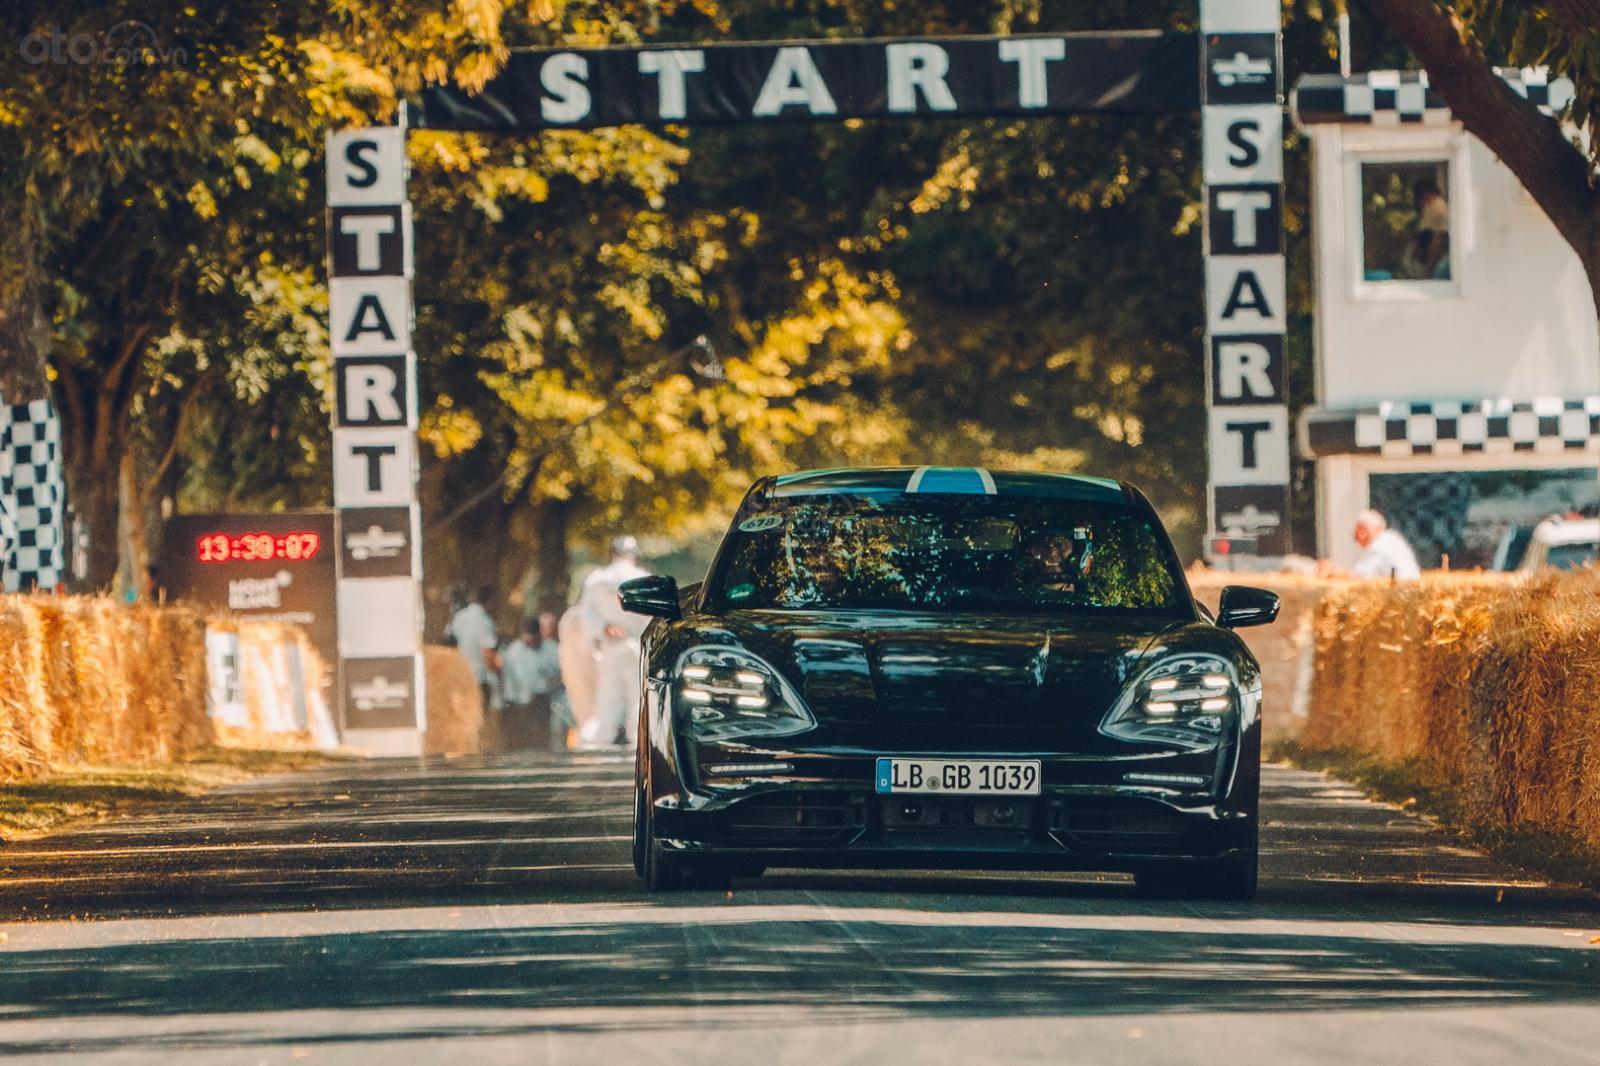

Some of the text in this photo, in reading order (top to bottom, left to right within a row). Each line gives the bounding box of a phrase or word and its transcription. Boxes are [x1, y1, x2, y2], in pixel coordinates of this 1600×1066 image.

[539, 38, 1066, 124] START
[340, 139, 402, 493] START
[1216, 120, 1275, 469] START
[892, 763, 923, 789] LB
[942, 764, 971, 790] GB
[979, 765, 1036, 791] 1039
